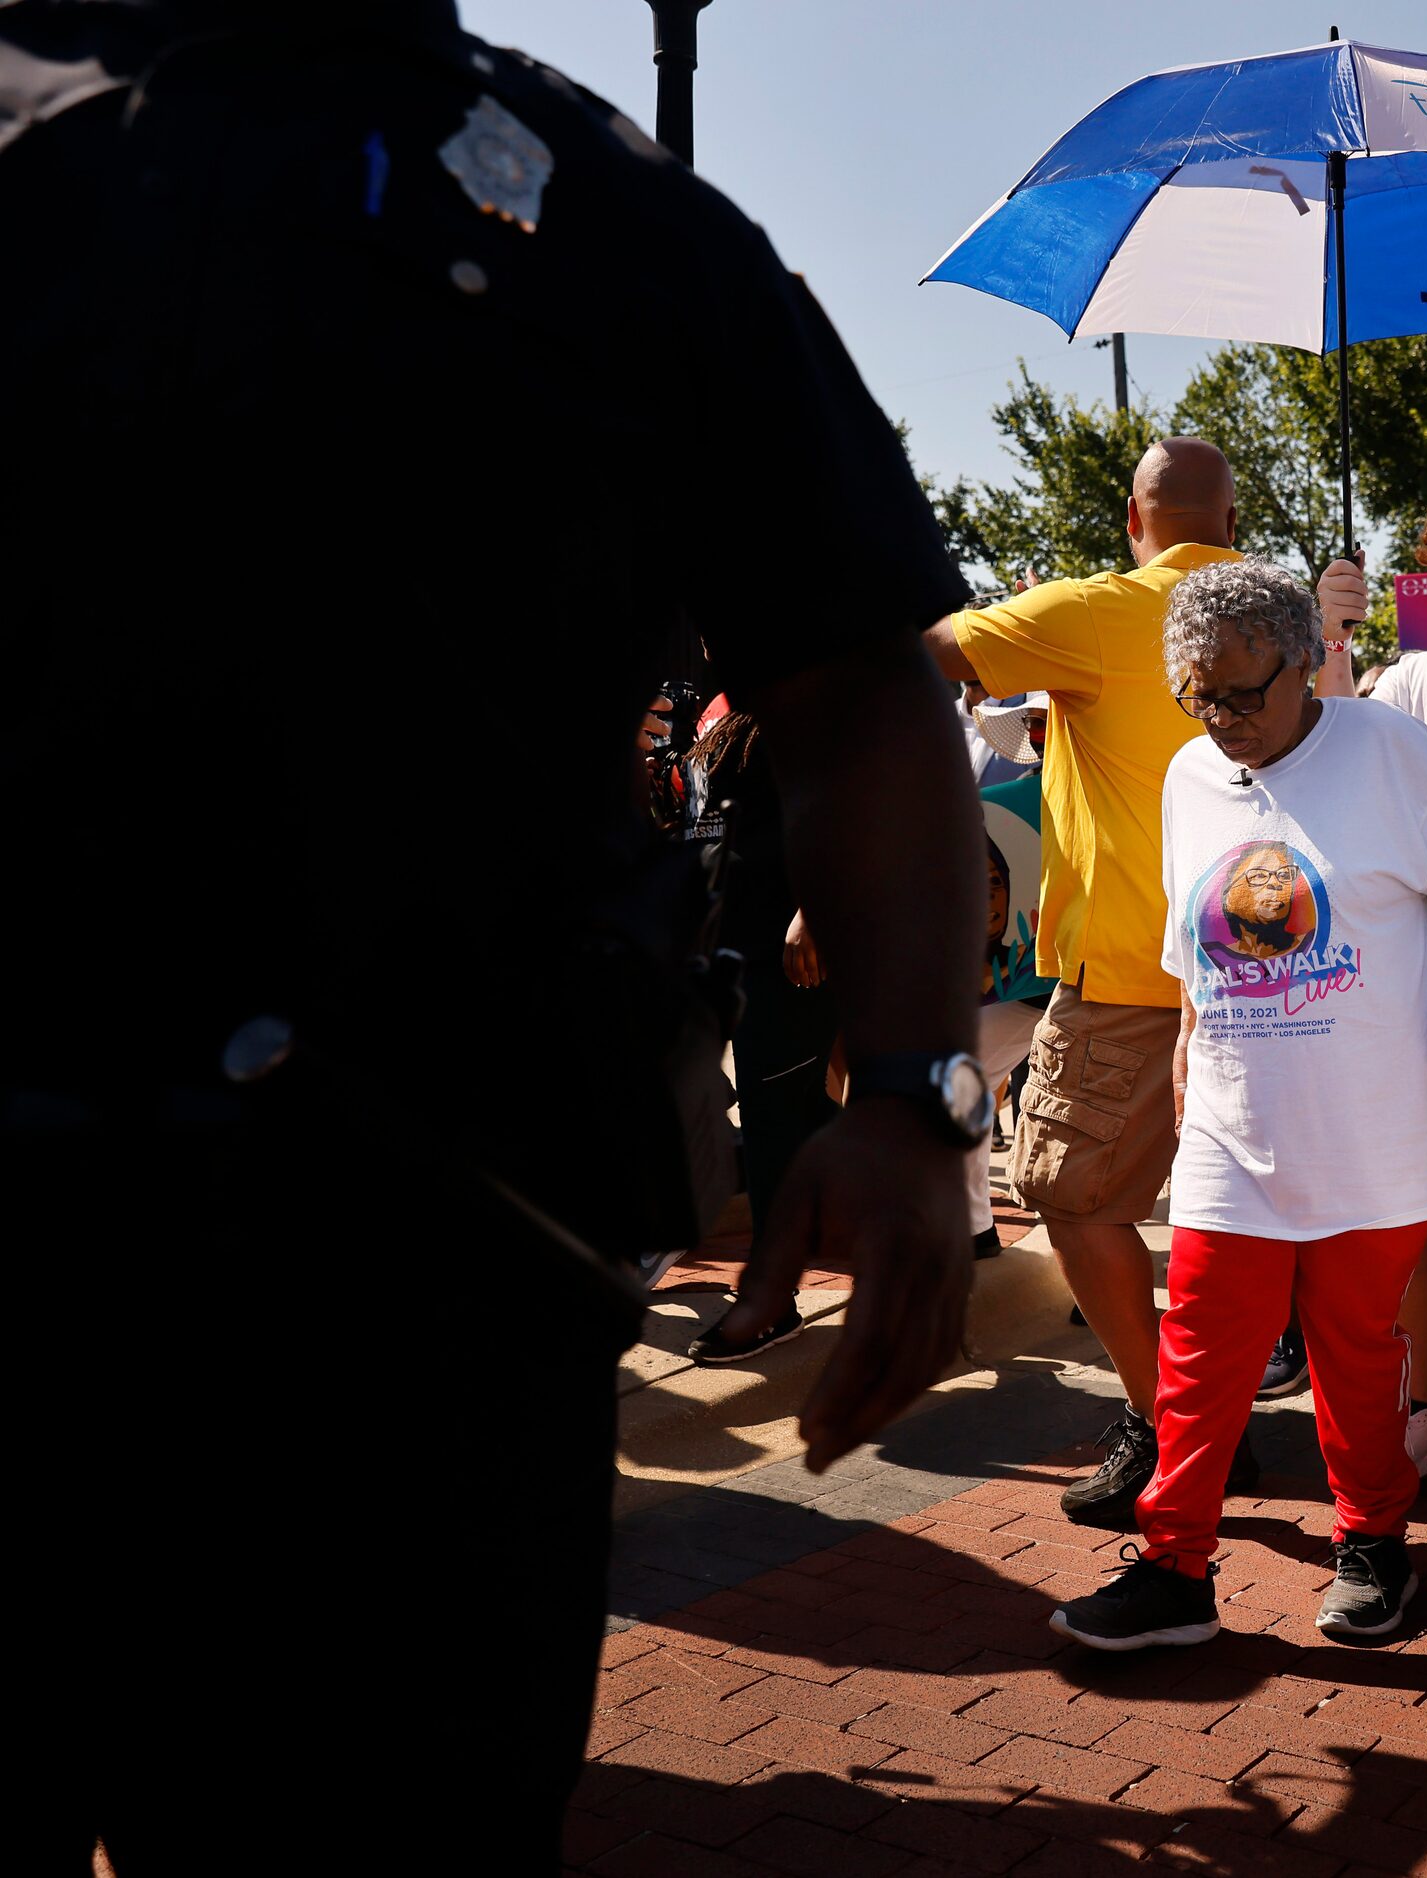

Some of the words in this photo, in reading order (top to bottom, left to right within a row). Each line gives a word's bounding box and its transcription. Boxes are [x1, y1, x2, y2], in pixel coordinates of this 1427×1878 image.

[1264, 943, 1350, 980] WALK
[1201, 1010, 1228, 1019] JUNE
[1231, 1009, 1247, 1020] 19,
[1250, 1008, 1277, 1018] 2021
[1271, 1020, 1323, 1028] WASHINGTON
[1295, 1027, 1331, 1036] ANGELES
